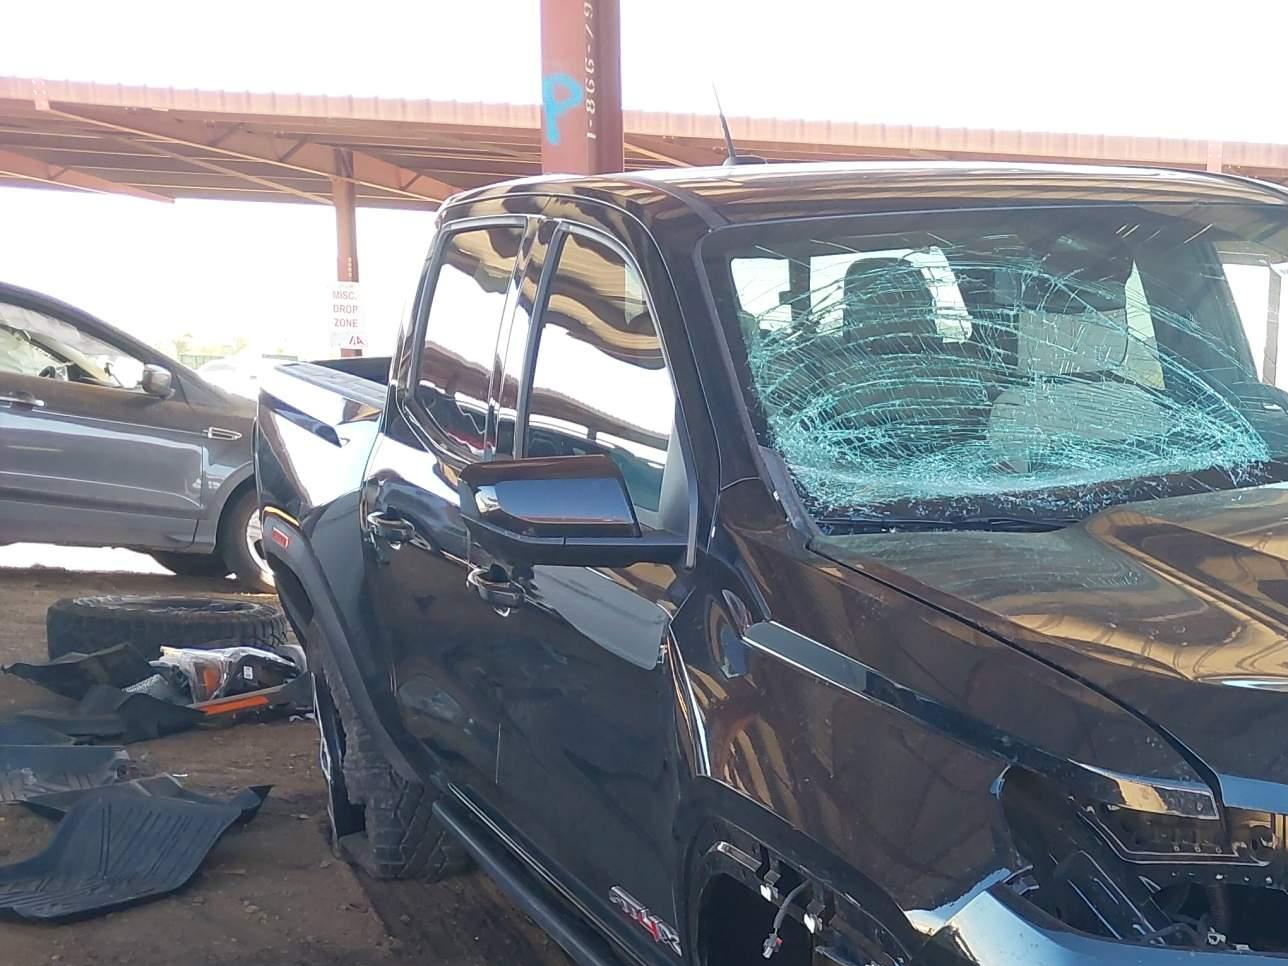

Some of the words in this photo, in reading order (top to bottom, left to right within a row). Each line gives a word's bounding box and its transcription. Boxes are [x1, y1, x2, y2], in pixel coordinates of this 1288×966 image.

[542, 72, 584, 146] P
[332, 290, 358, 301] MISC.
[332, 304, 359, 314] DROP
[333, 318, 359, 329] ZONE
